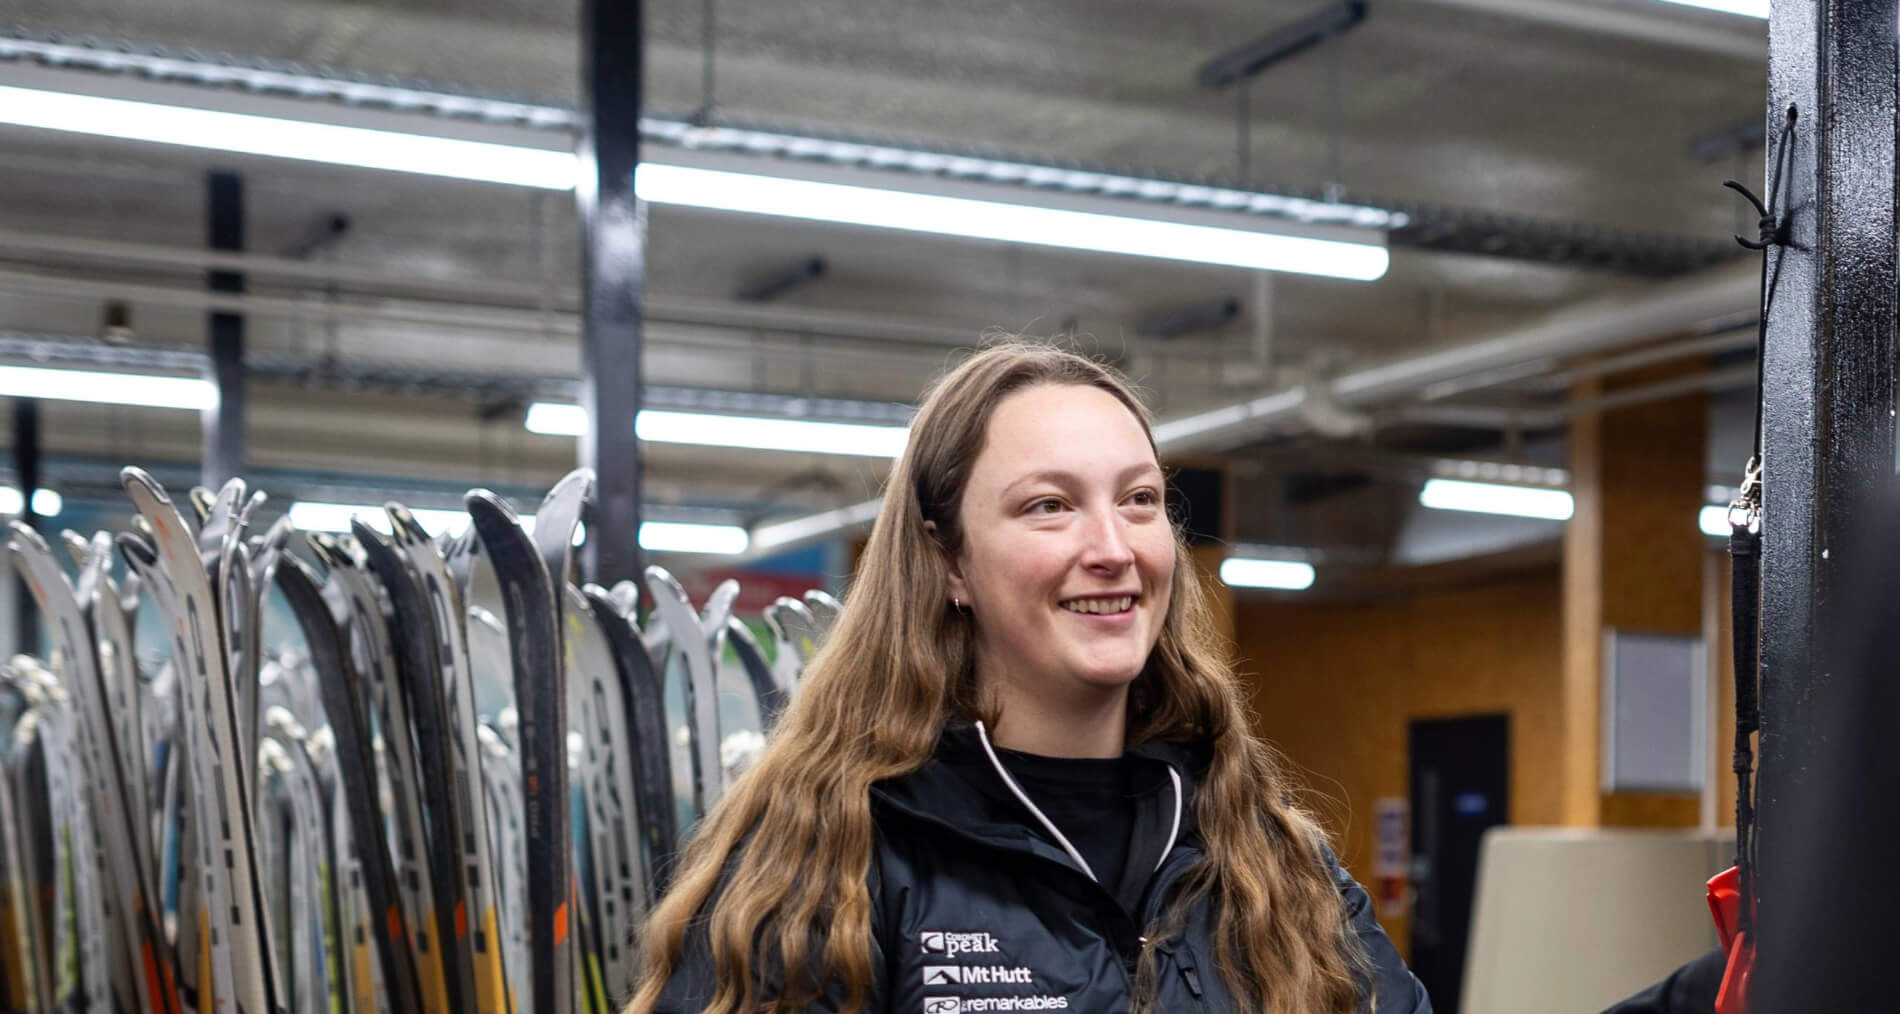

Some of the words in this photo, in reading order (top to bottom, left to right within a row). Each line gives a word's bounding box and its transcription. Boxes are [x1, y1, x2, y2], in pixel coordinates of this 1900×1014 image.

[946, 932, 999, 958] peak
[963, 966, 990, 984] Mt
[991, 966, 1033, 984] Hutt
[967, 995, 1068, 1011] remarkables
